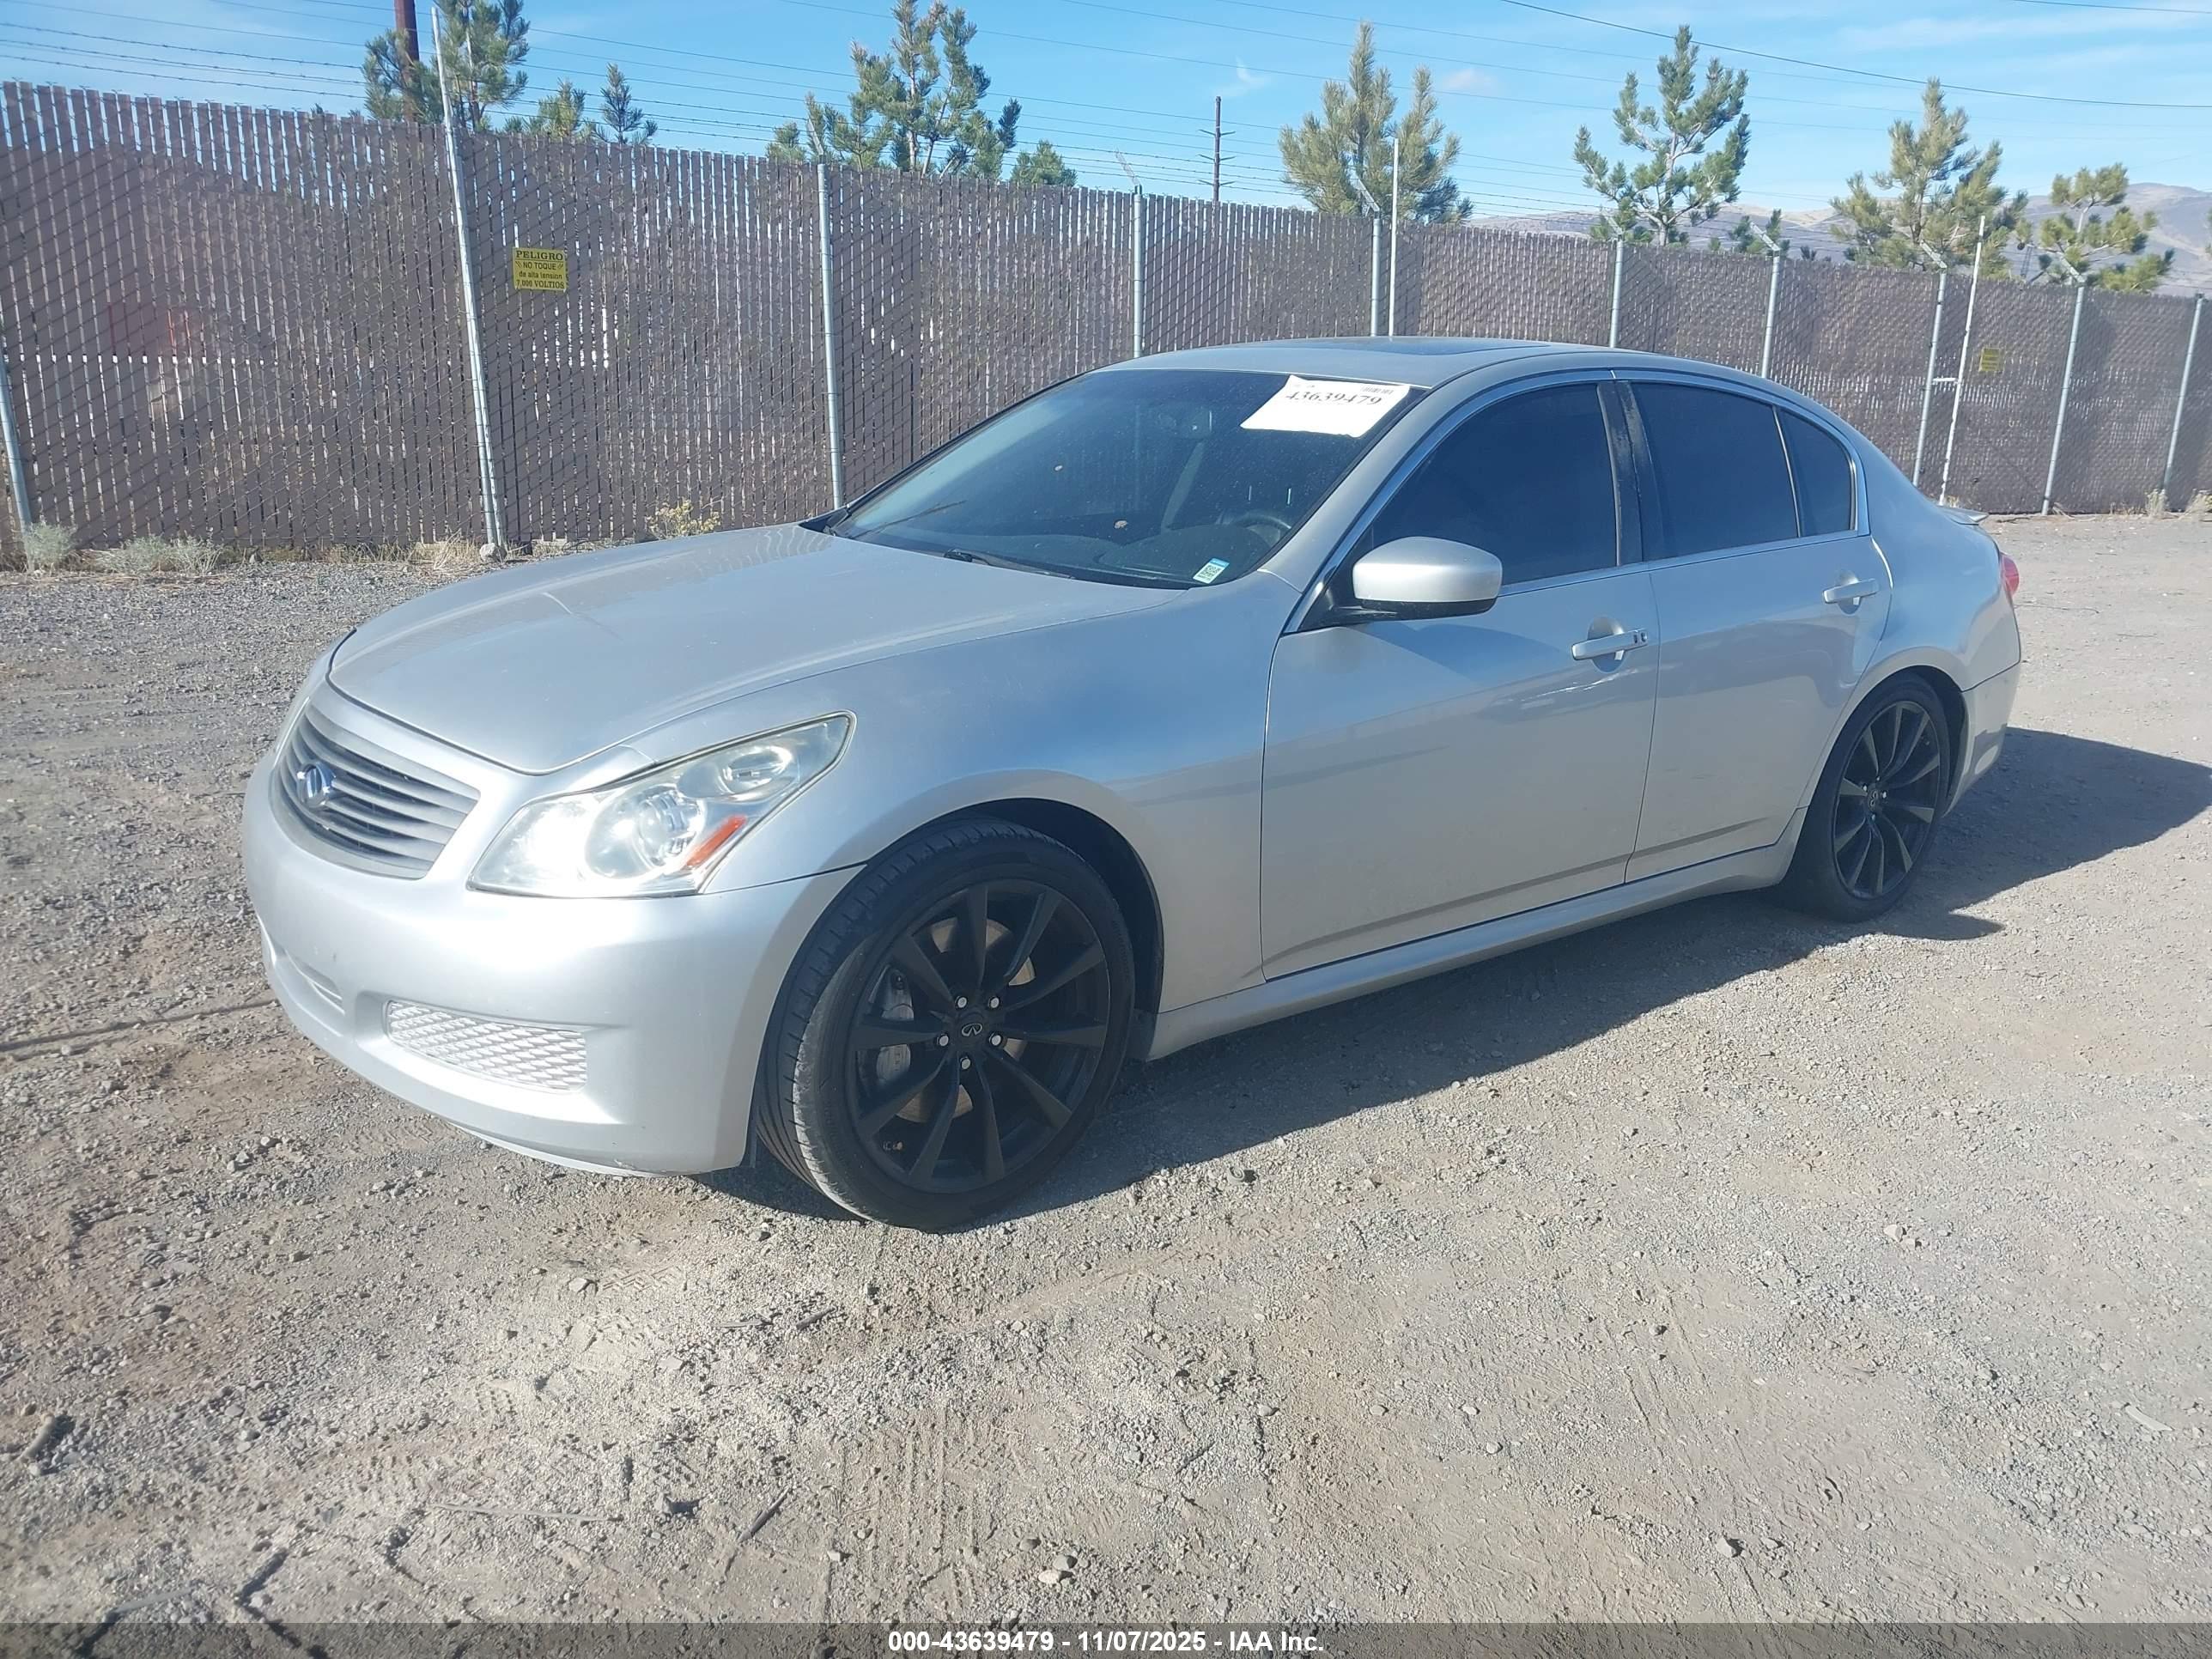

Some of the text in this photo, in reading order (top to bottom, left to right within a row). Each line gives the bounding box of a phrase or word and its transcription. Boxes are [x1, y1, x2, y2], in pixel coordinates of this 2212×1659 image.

[515, 250, 563, 261] PELIGRO
[535, 262, 556, 270] TOQUE
[534, 280, 565, 289] VOLTIOS
[1285, 391, 1382, 405] 43639479
